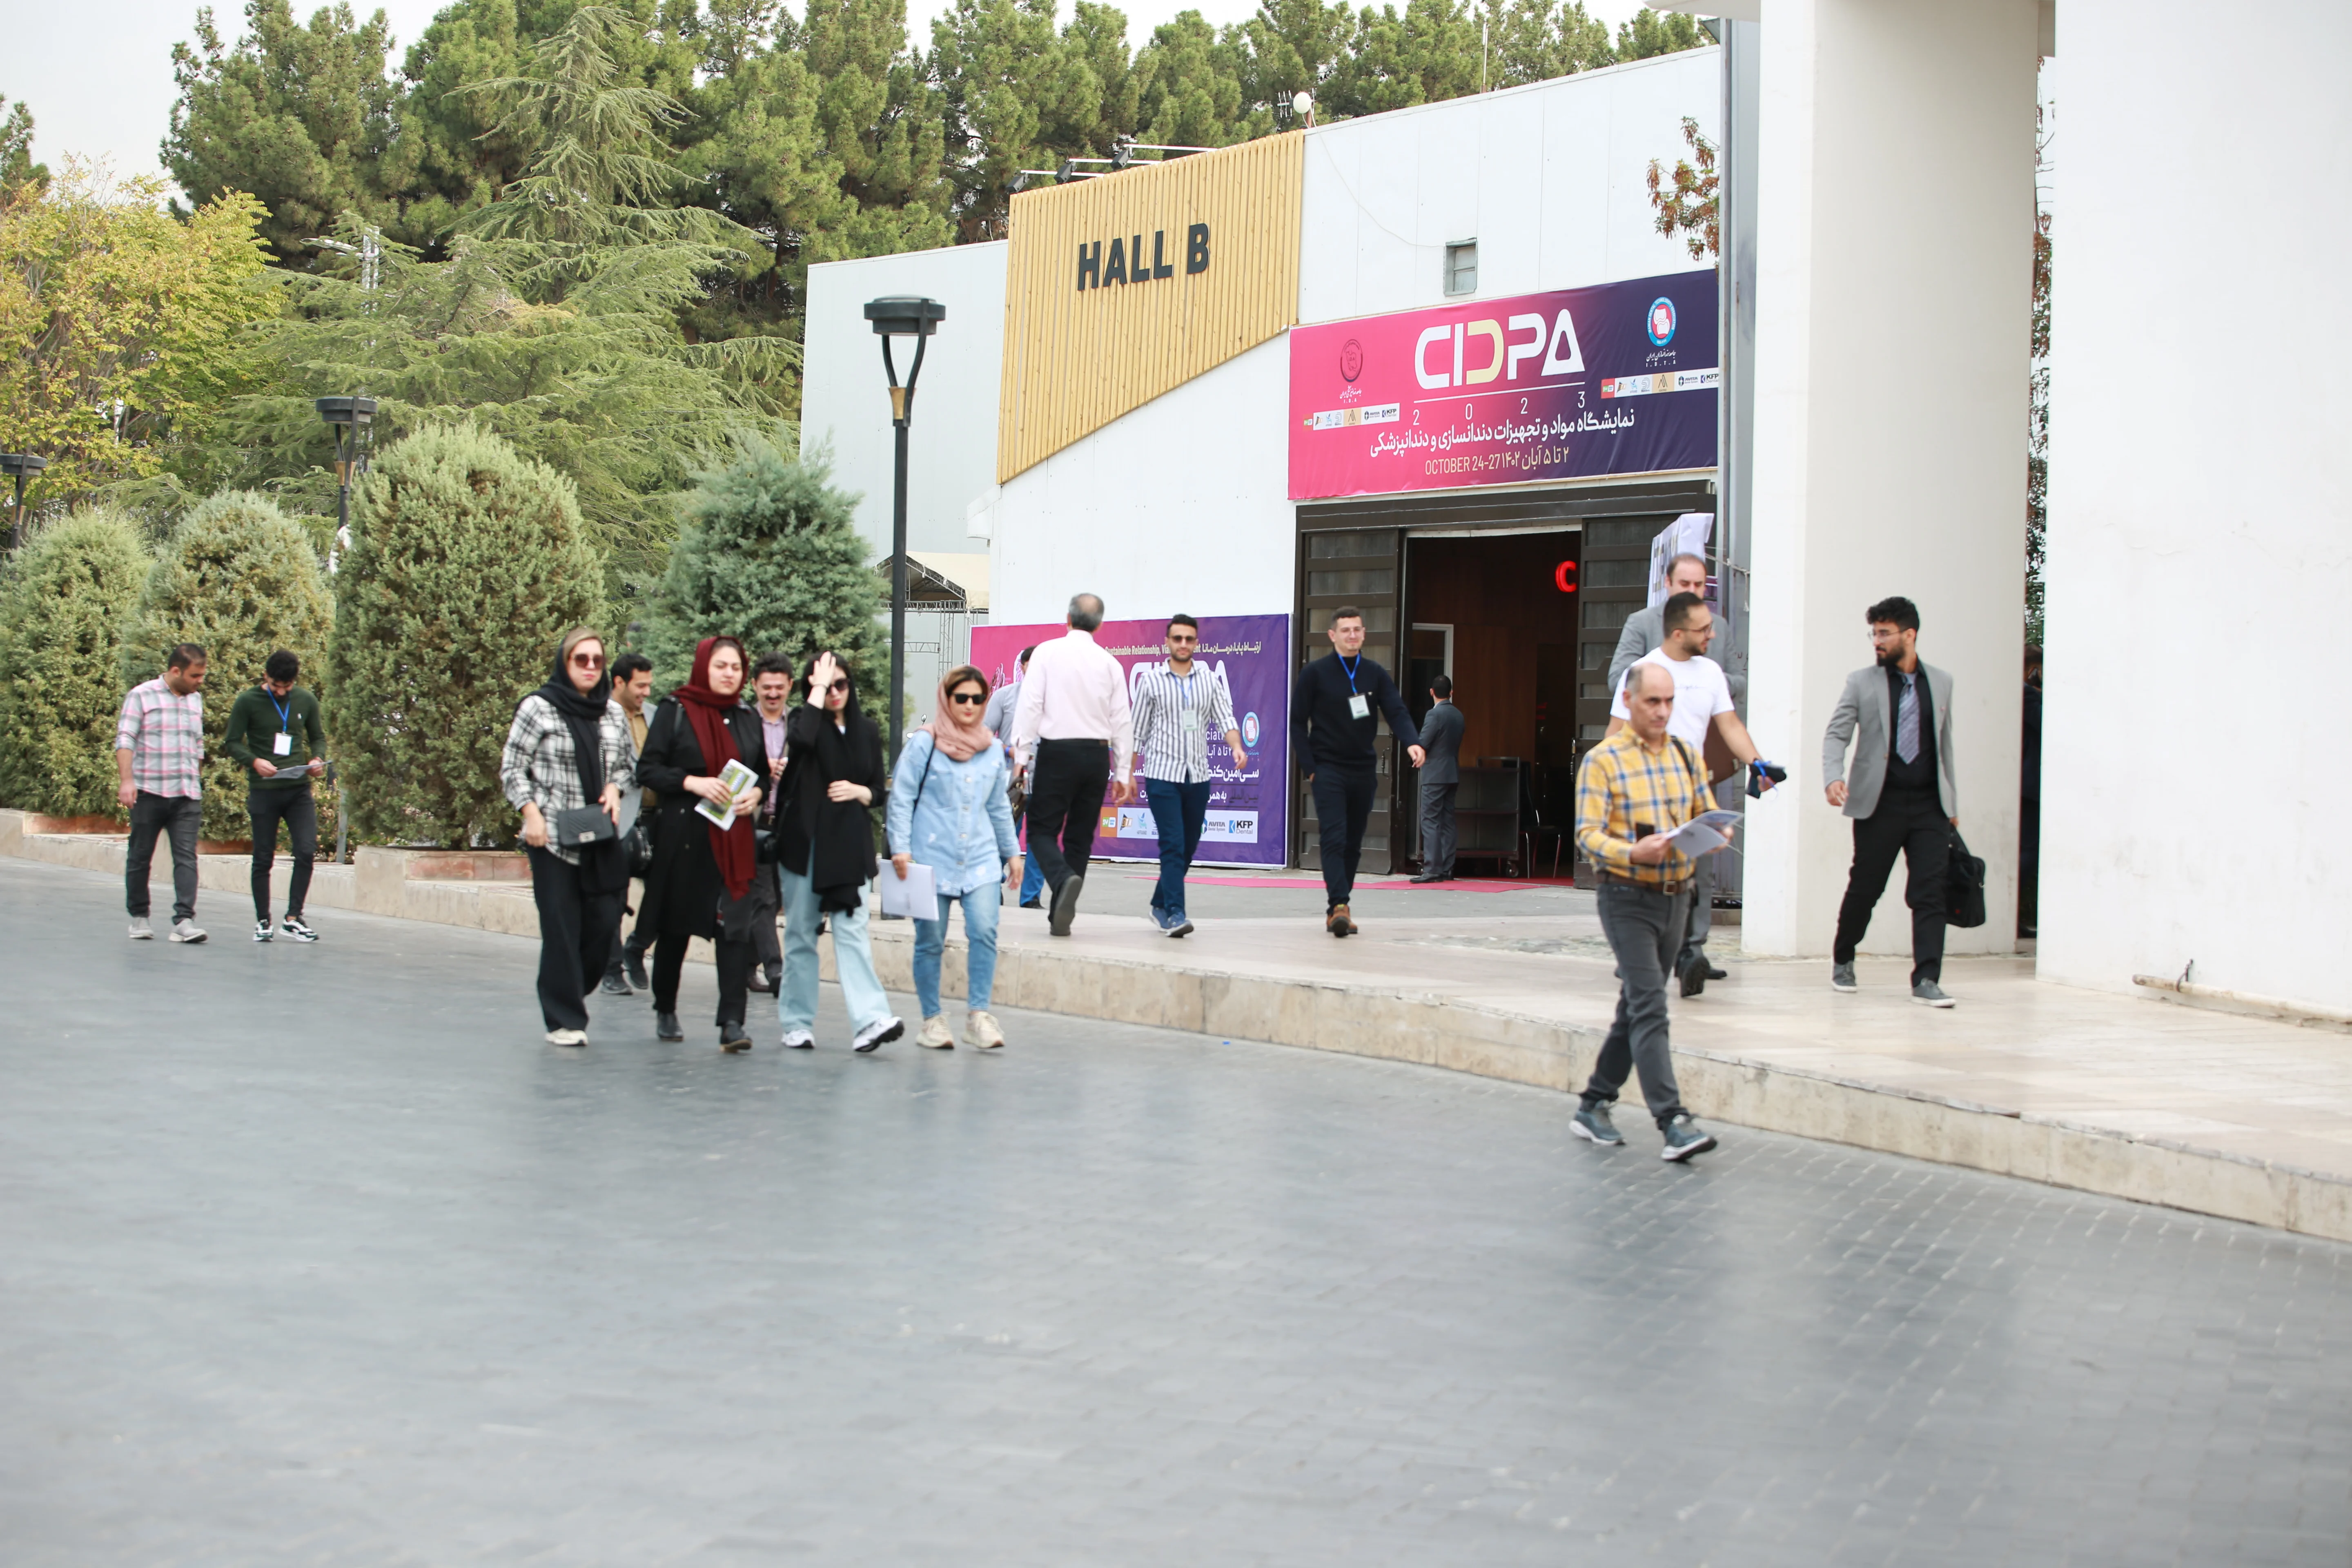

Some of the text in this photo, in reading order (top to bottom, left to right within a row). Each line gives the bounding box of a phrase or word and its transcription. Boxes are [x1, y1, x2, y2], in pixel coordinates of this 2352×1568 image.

[1078, 223, 1209, 291] HALL B
[1414, 309, 1585, 390] CIDPA
[1413, 391, 1585, 425] 2 0 2 3
[1370, 408, 1634, 458] نمایشگاه مواد و تجهیزات دندانسازی و دندانپزشکی
[1522, 445, 1542, 470] آبان
[1544, 449, 1551, 464] ۵
[1553, 445, 1561, 463] تا
[1563, 447, 1569, 463] ۲
[1425, 456, 1470, 475] OCTOBER
[1105, 645, 1131, 656] Sustainable
[1132, 644, 1161, 657] Relationship,
[1236, 820, 1253, 829] KFP
